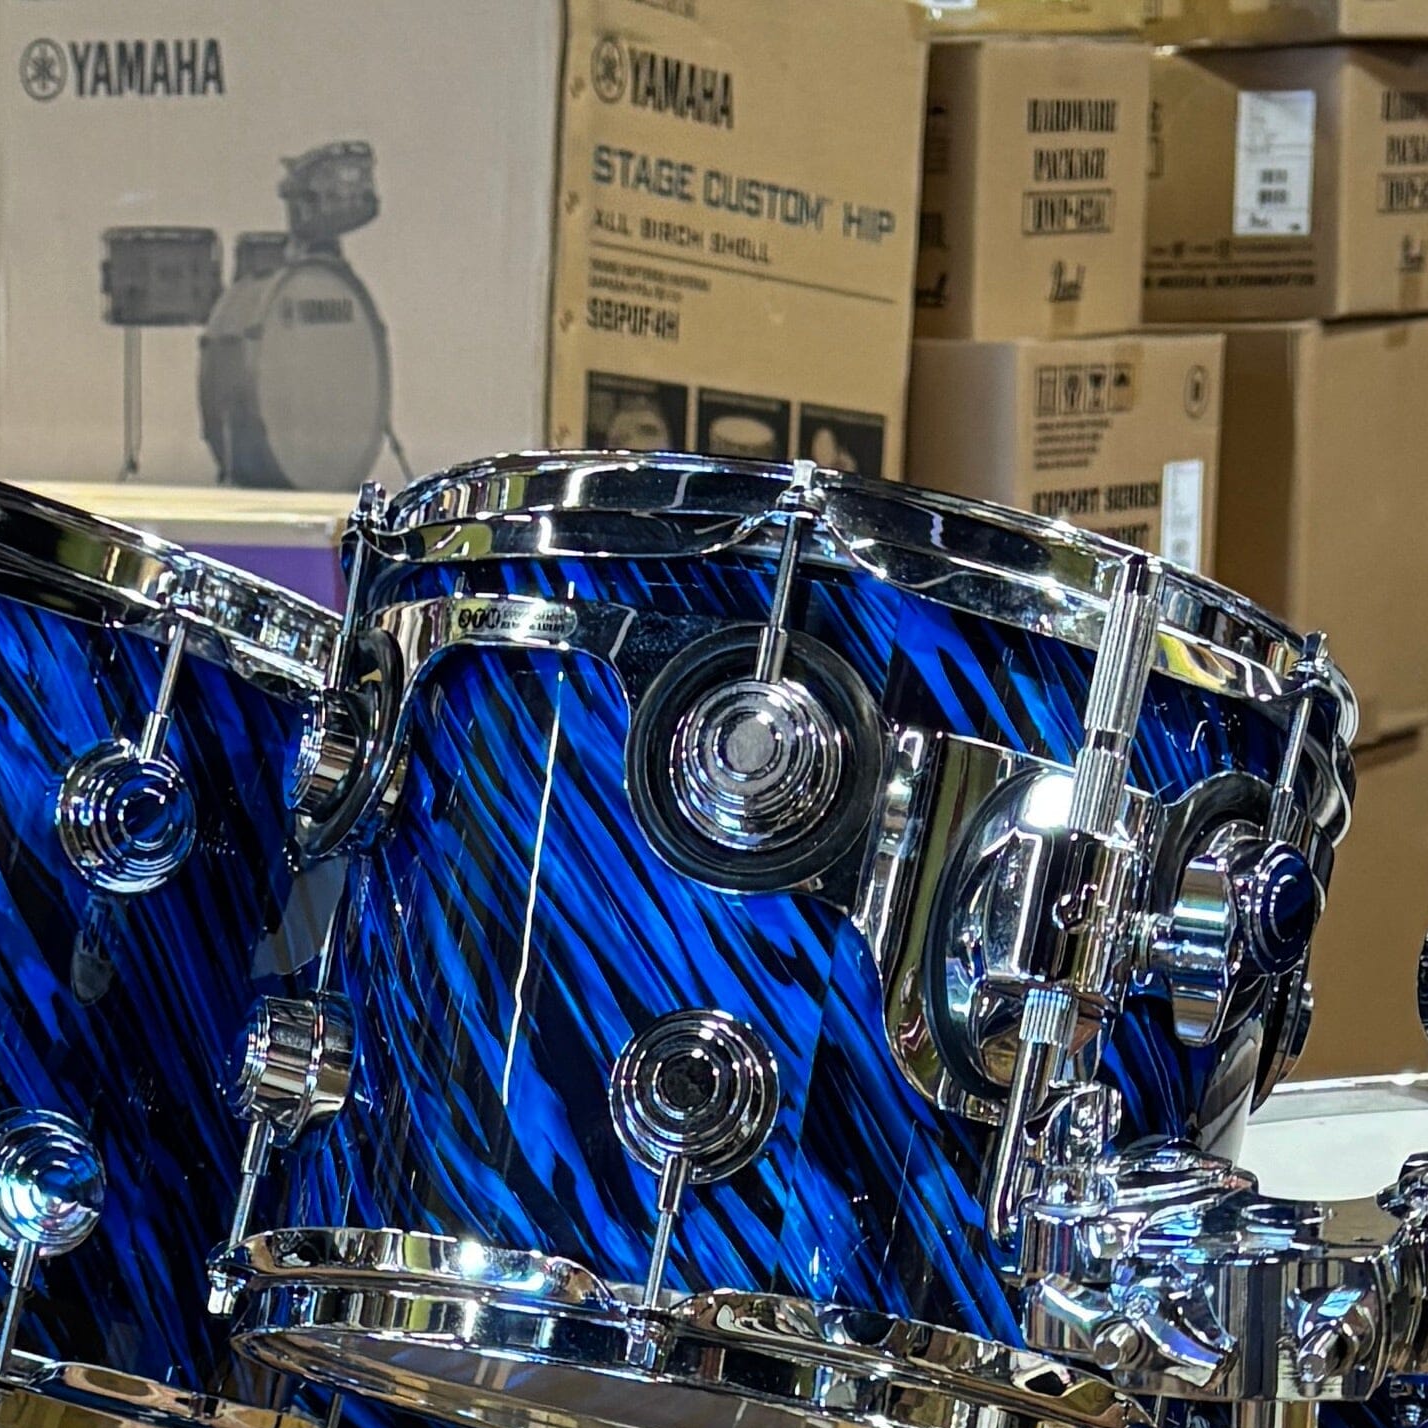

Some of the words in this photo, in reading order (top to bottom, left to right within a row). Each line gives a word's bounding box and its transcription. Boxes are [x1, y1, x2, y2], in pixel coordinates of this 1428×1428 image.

[68, 38, 226, 97] YAMAHA
[628, 46, 734, 130] YAMAHA
[591, 144, 695, 203] STAGE
[702, 168, 824, 230] CUSTOM
[842, 203, 896, 244] HIP
[1104, 481, 1160, 512] SERIES
